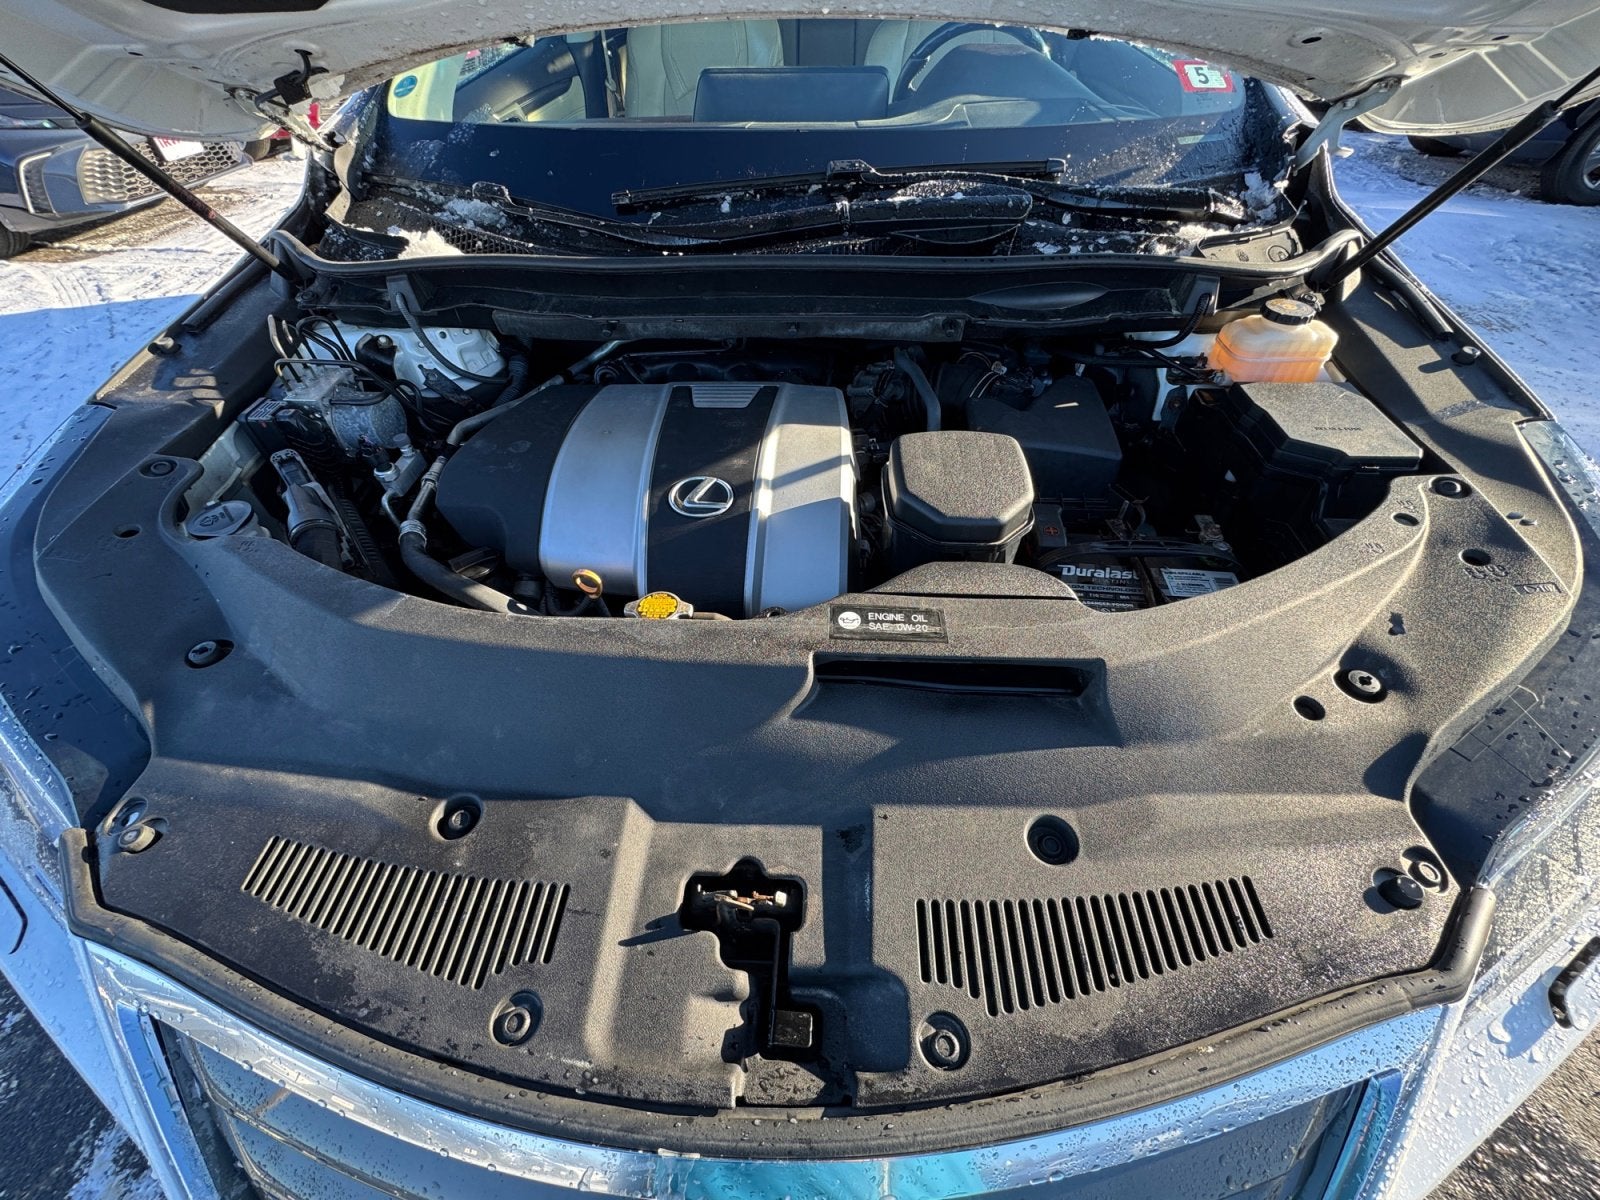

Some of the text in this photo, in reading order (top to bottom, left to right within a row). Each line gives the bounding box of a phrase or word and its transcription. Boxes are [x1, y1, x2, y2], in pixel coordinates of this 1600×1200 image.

[1194, 66, 1210, 85] 5
[1057, 564, 1140, 580] Duralast
[868, 612, 928, 623] ENGINE OIL
[868, 622, 928, 632] SAE 0W-20
